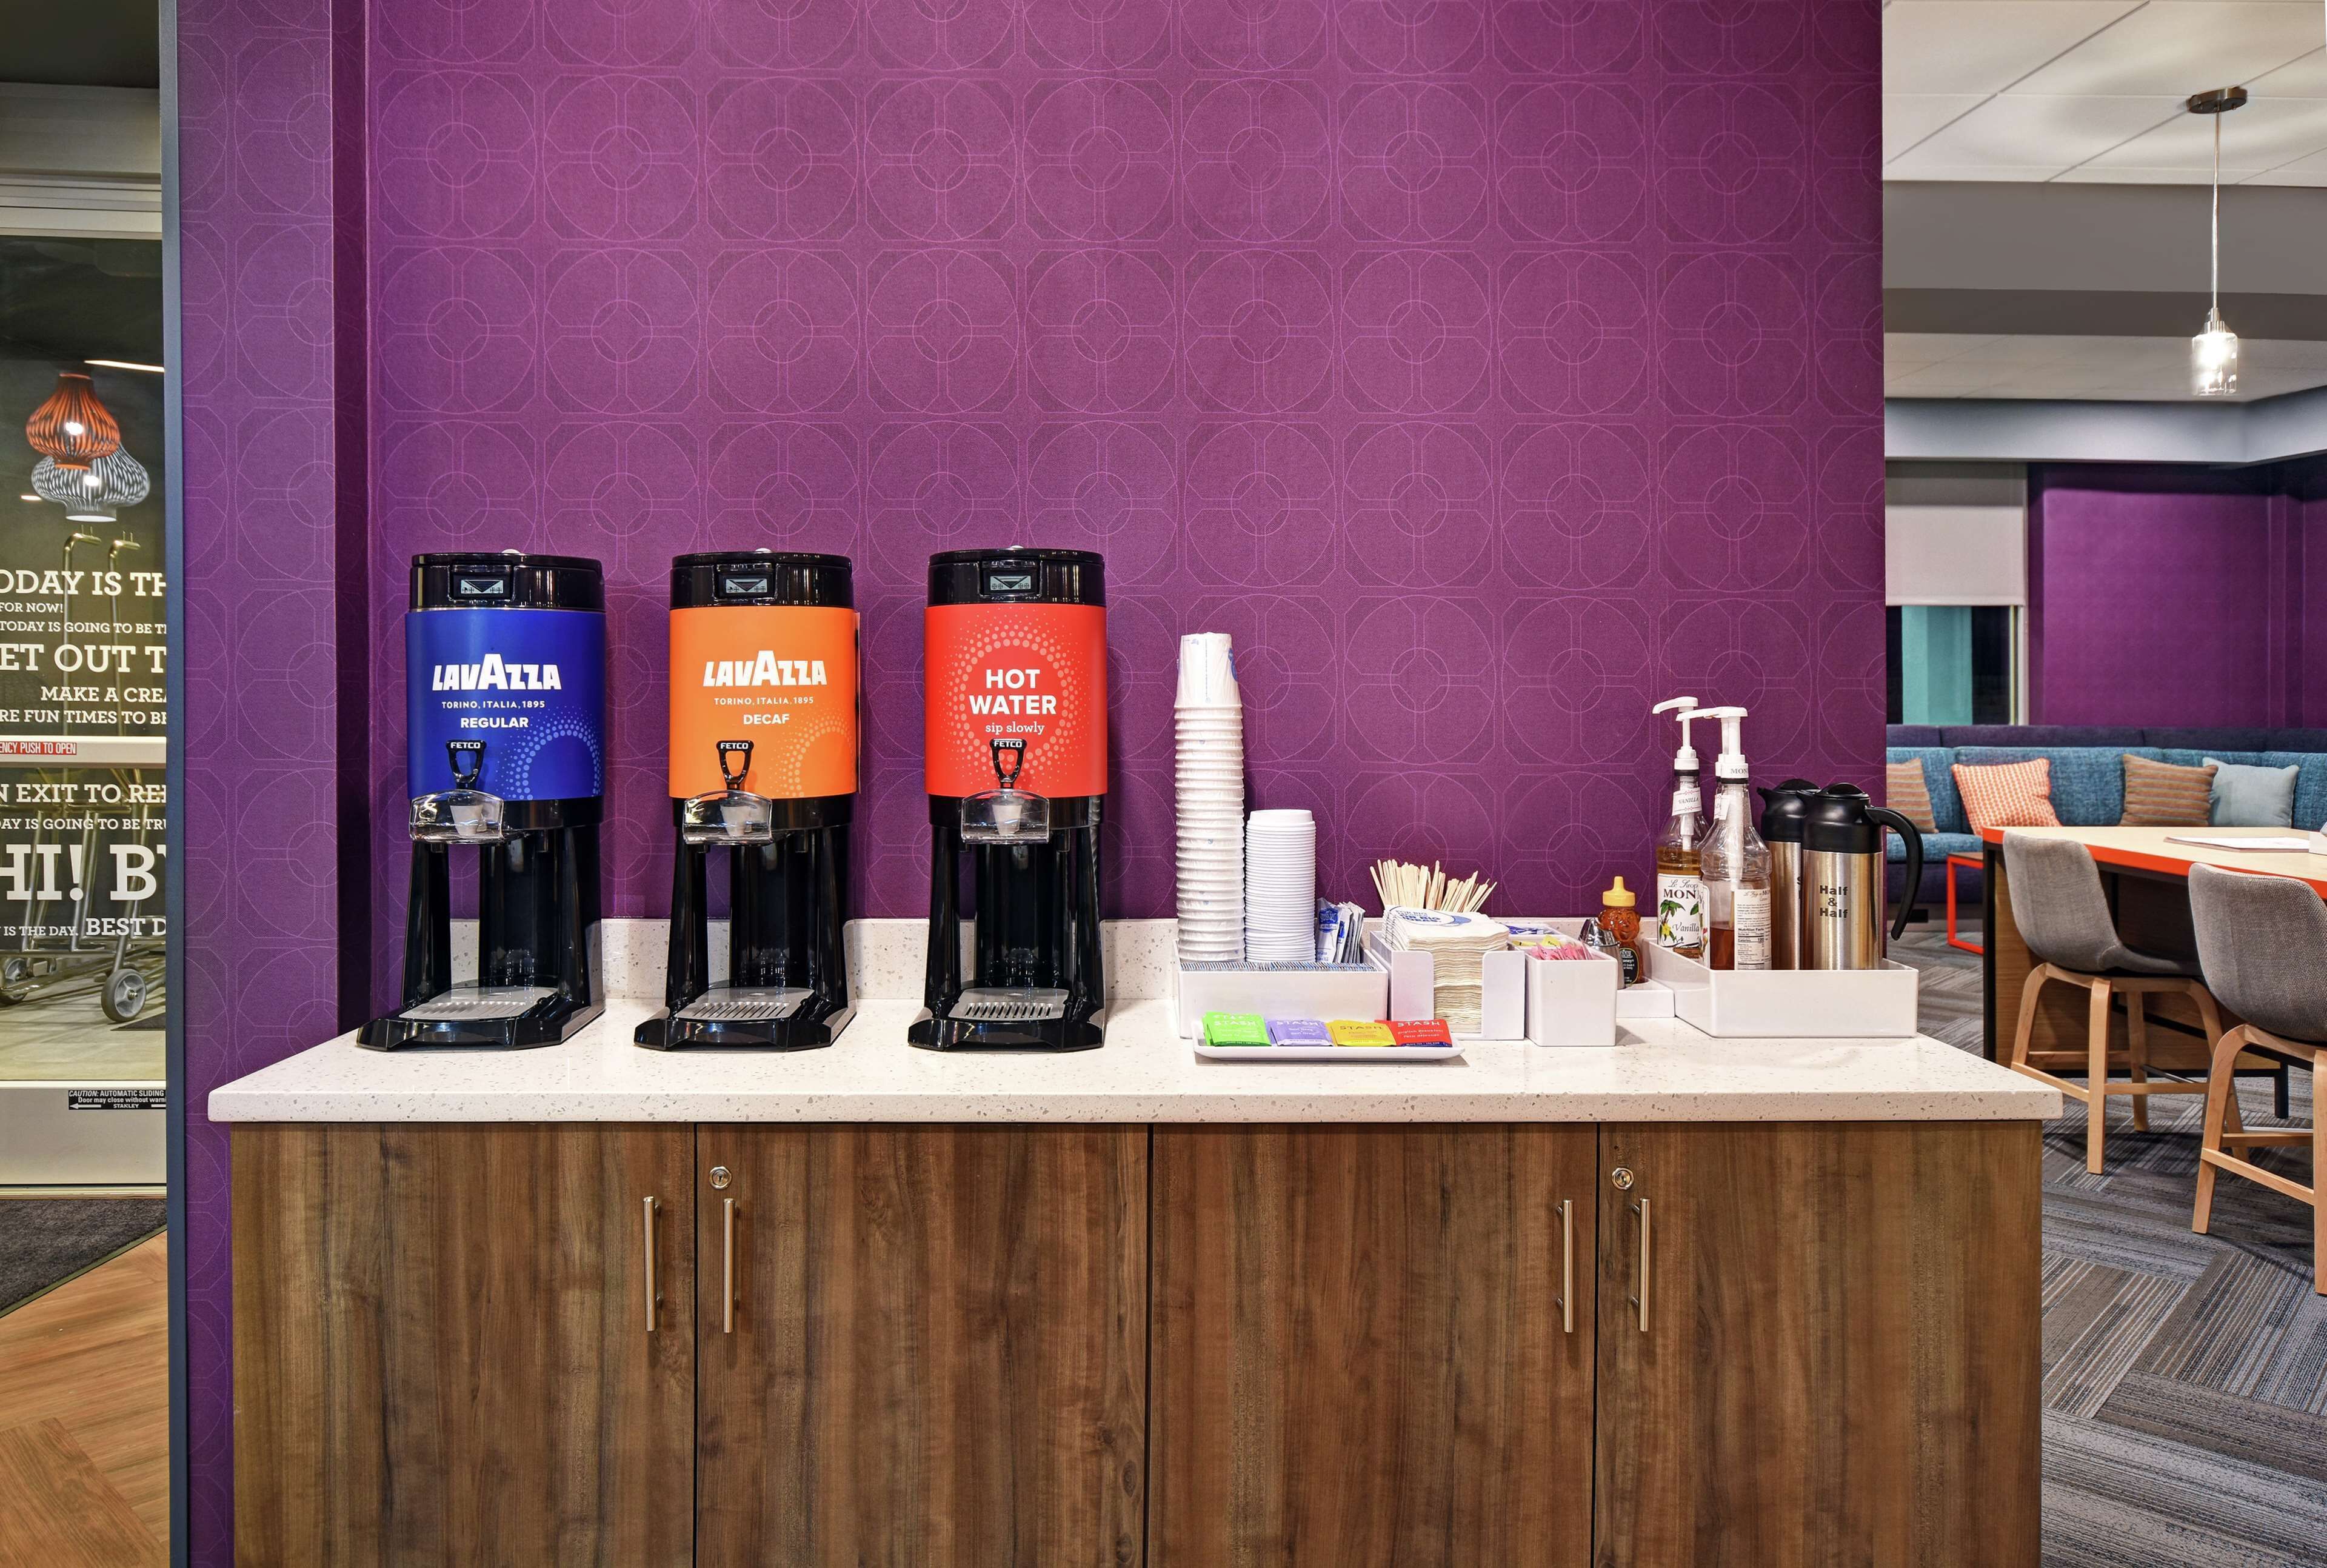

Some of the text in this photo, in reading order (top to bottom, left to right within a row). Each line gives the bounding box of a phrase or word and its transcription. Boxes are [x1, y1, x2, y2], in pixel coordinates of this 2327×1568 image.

[92, 572, 121, 596] IS
[0, 602, 64, 613] FOR NOW!
[0, 621, 45, 632] TODAY
[48, 621, 61, 632] IS
[64, 622, 110, 633] GOING
[113, 622, 132, 633] TO
[136, 623, 152, 634] BE
[55, 644, 136, 673] OUT
[432, 653, 562, 691] LAVAZZA
[703, 650, 827, 687] LAVAZZA
[986, 669, 1040, 689] HOT
[41, 686, 99, 702] MAKE
[104, 687, 119, 702] A
[969, 695, 1057, 715] WATER
[24, 710, 60, 723] FUN
[64, 710, 117, 724] TIMES
[121, 711, 145, 724] TO
[461, 717, 529, 728] REGULAR
[743, 714, 790, 724] DECAF
[986, 721, 1045, 735] sip slowly
[20, 742, 41, 753] PUSH
[43, 742, 53, 754] TO
[56, 742, 76, 754] OPEN
[16, 784, 78, 802] EXIT
[84, 784, 121, 803] TO
[0, 818, 22, 829] AY
[25, 818, 39, 829] IS
[42, 818, 93, 830] GOING
[97, 818, 118, 830] TO
[122, 818, 141, 830] BE
[110, 844, 166, 901] B
[1820, 885, 1848, 895] Half
[1828, 898, 1837, 907] &
[1820, 907, 1848, 918] Half
[4, 918, 166, 936] IS THE DAY. BEST D
[1672, 922, 1699, 932] Vanilla
